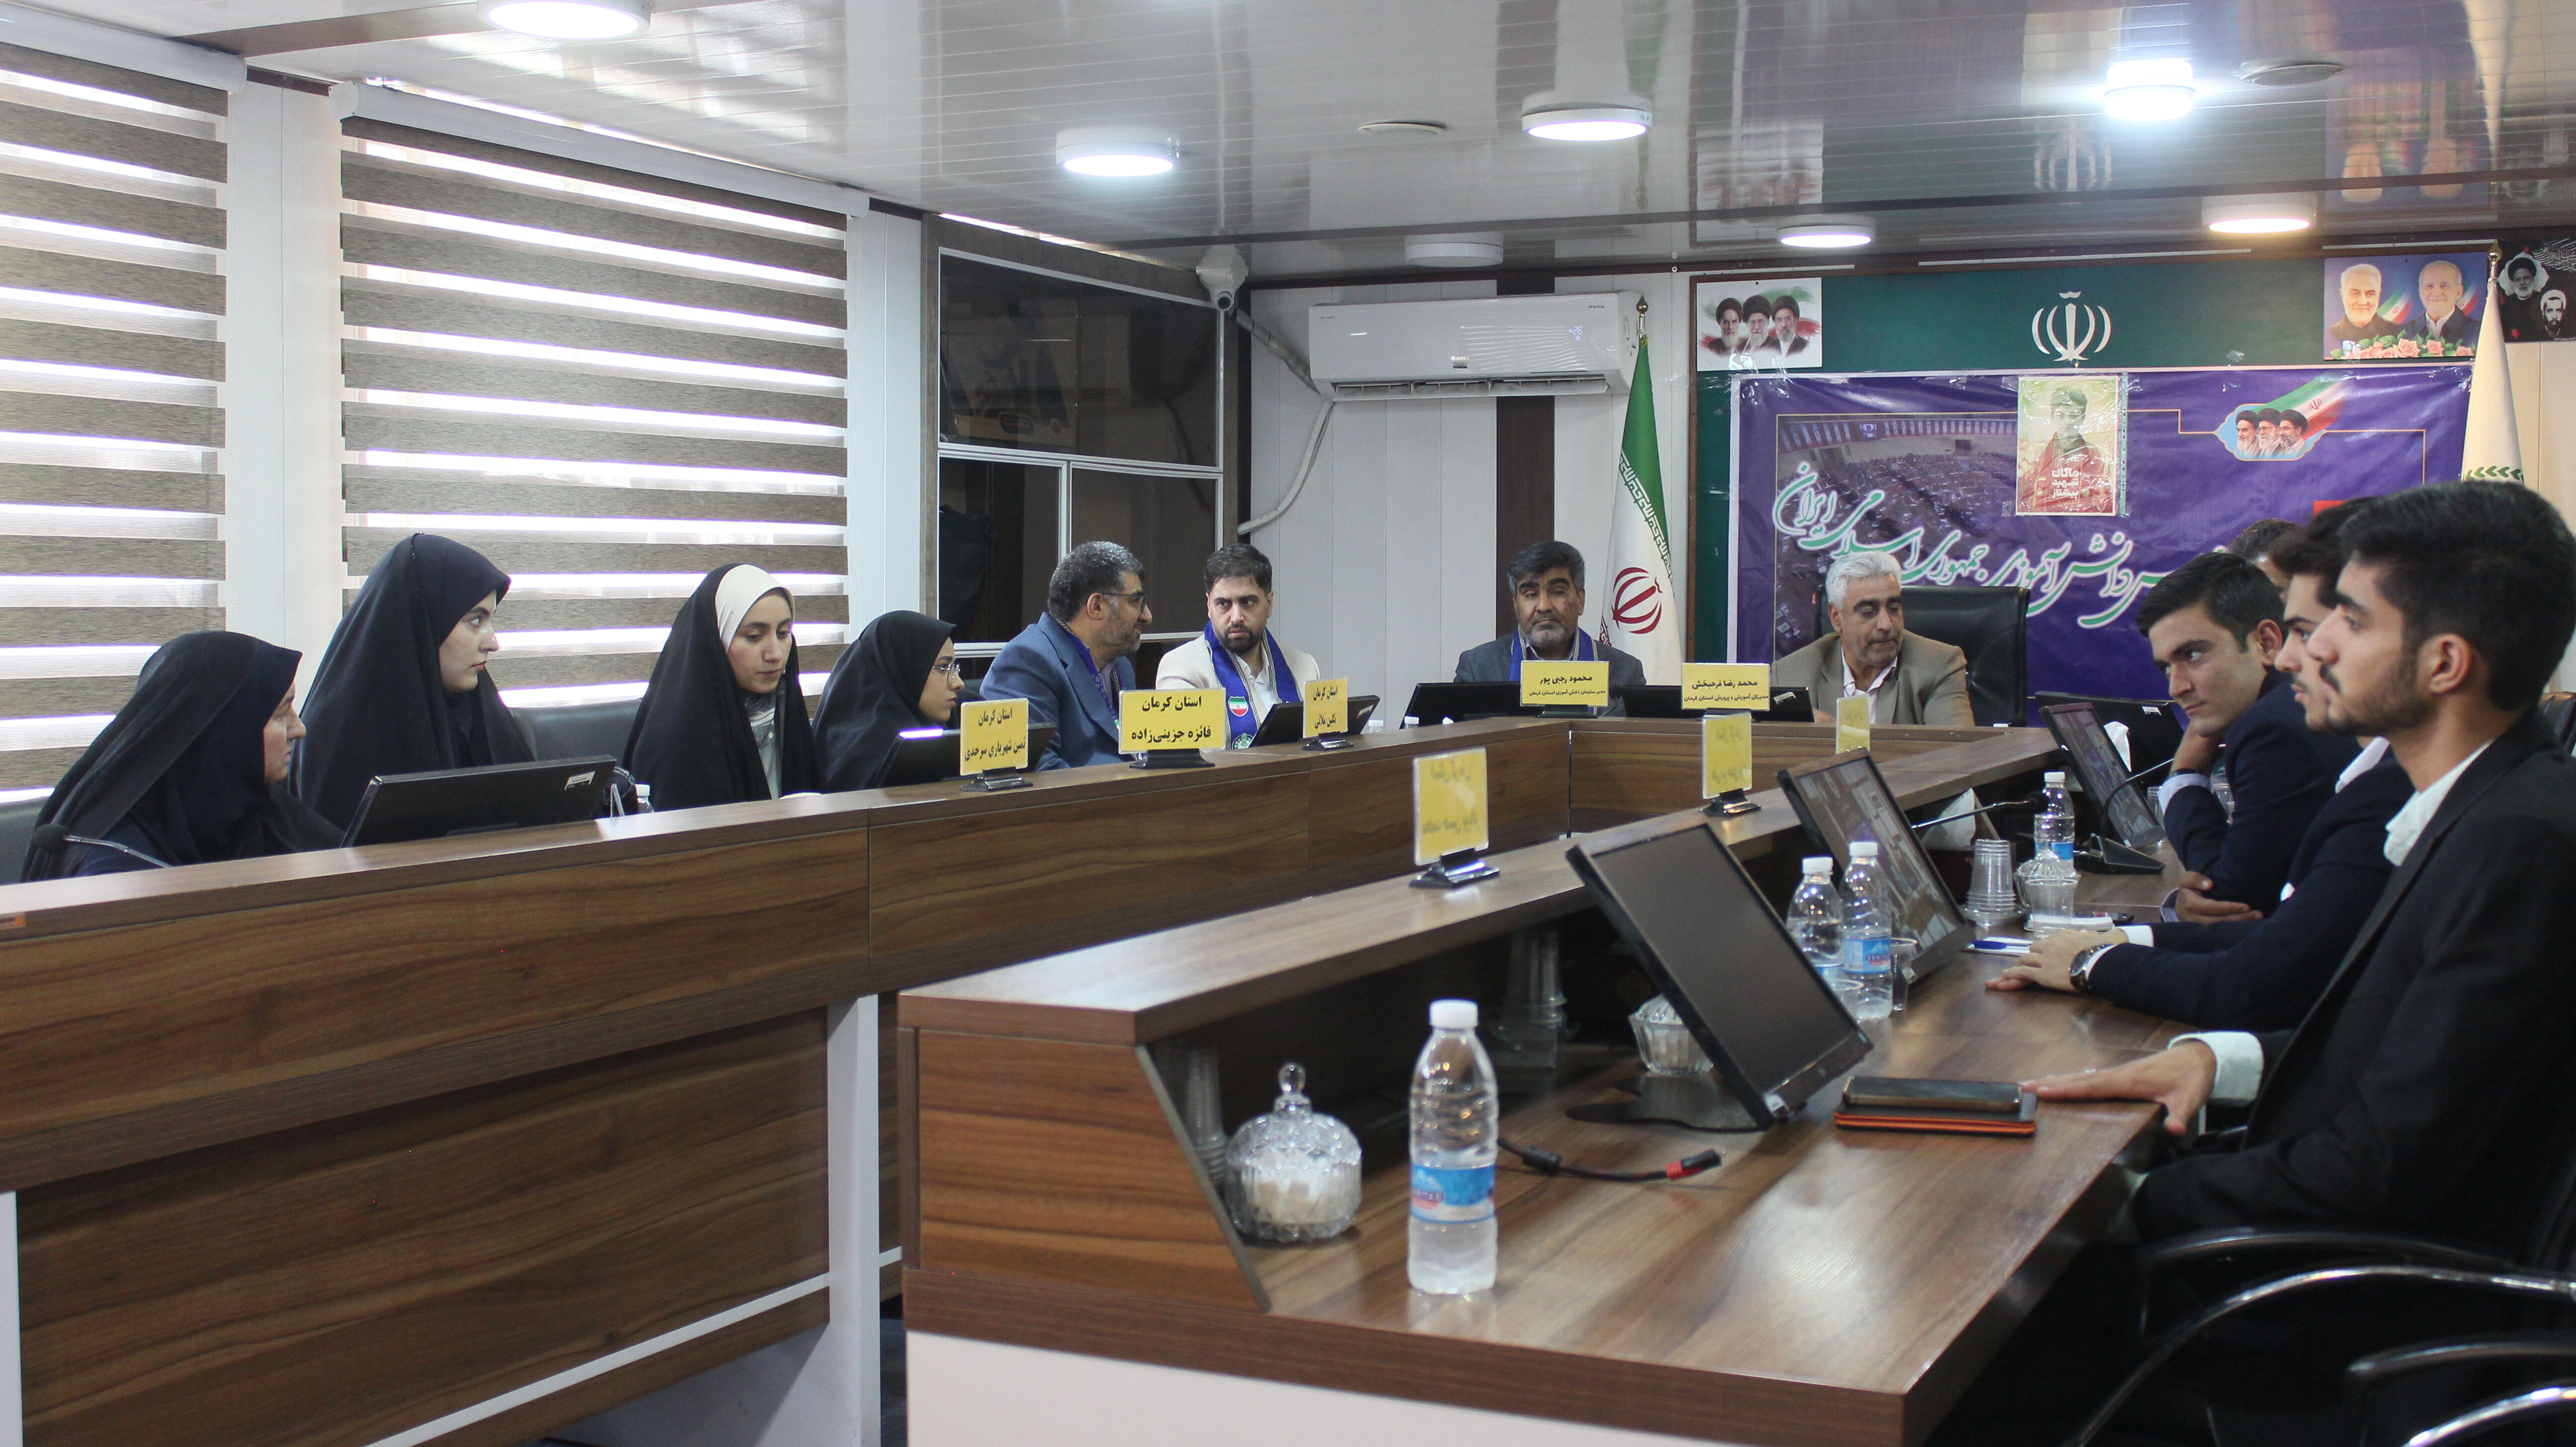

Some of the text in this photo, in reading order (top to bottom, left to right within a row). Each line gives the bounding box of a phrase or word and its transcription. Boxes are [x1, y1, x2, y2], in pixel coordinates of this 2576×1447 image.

[2051, 467, 2079, 478] ماکان
[2051, 478, 2079, 488] شهید
[1772, 462, 1838, 536] ایران
[2051, 489, 2079, 500] پیشتاز
[1797, 489, 1925, 567] اسلامی
[1691, 679, 1722, 690] فرحبخش
[1723, 679, 1736, 689] رضا
[1313, 686, 1338, 701] استان کرمان
[1142, 695, 1202, 712] استان کرمان
[978, 707, 1013, 727] استان کرمان
[1327, 713, 1336, 727] نگین
[1188, 725, 1211, 742] فائزه
[988, 739, 1012, 758] شهریاری
